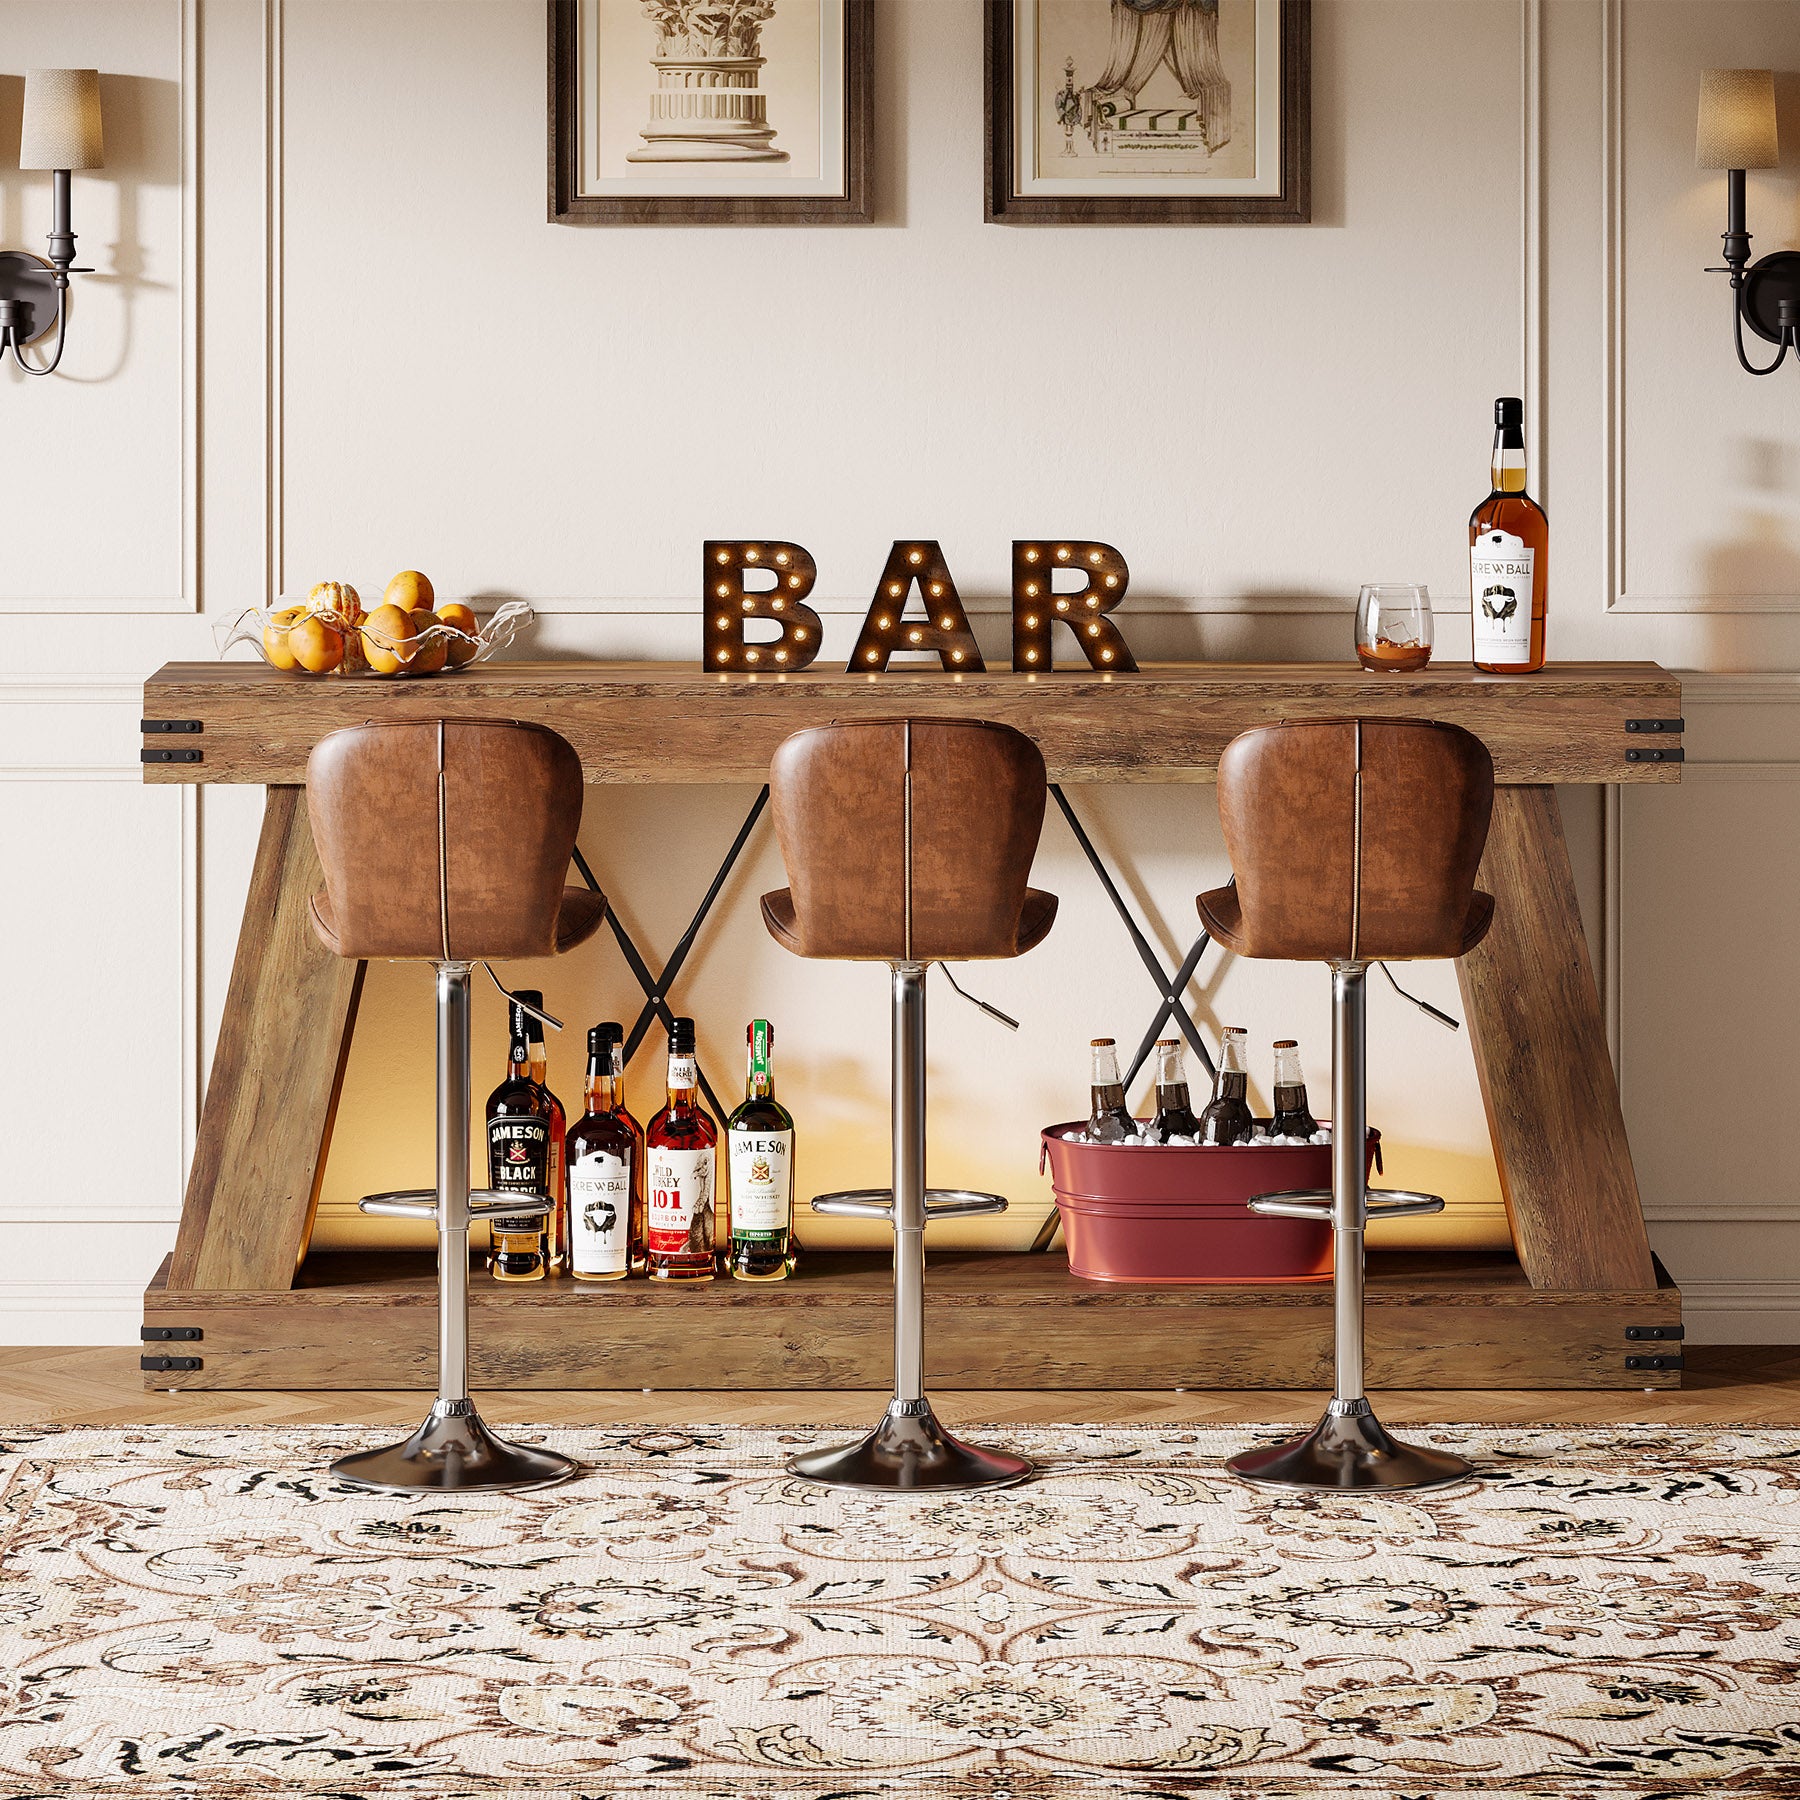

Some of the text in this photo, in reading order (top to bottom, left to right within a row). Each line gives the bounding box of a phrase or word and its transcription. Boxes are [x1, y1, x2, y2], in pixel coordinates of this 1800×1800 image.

[703, 540, 1140, 673] BAR
[755, 1030, 764, 1065] JAMESON
[492, 1126, 545, 1143] JAMESON
[735, 1140, 787, 1156] JAMESON
[500, 1166, 536, 1180] BLACK
[653, 1189, 683, 1209] 101
